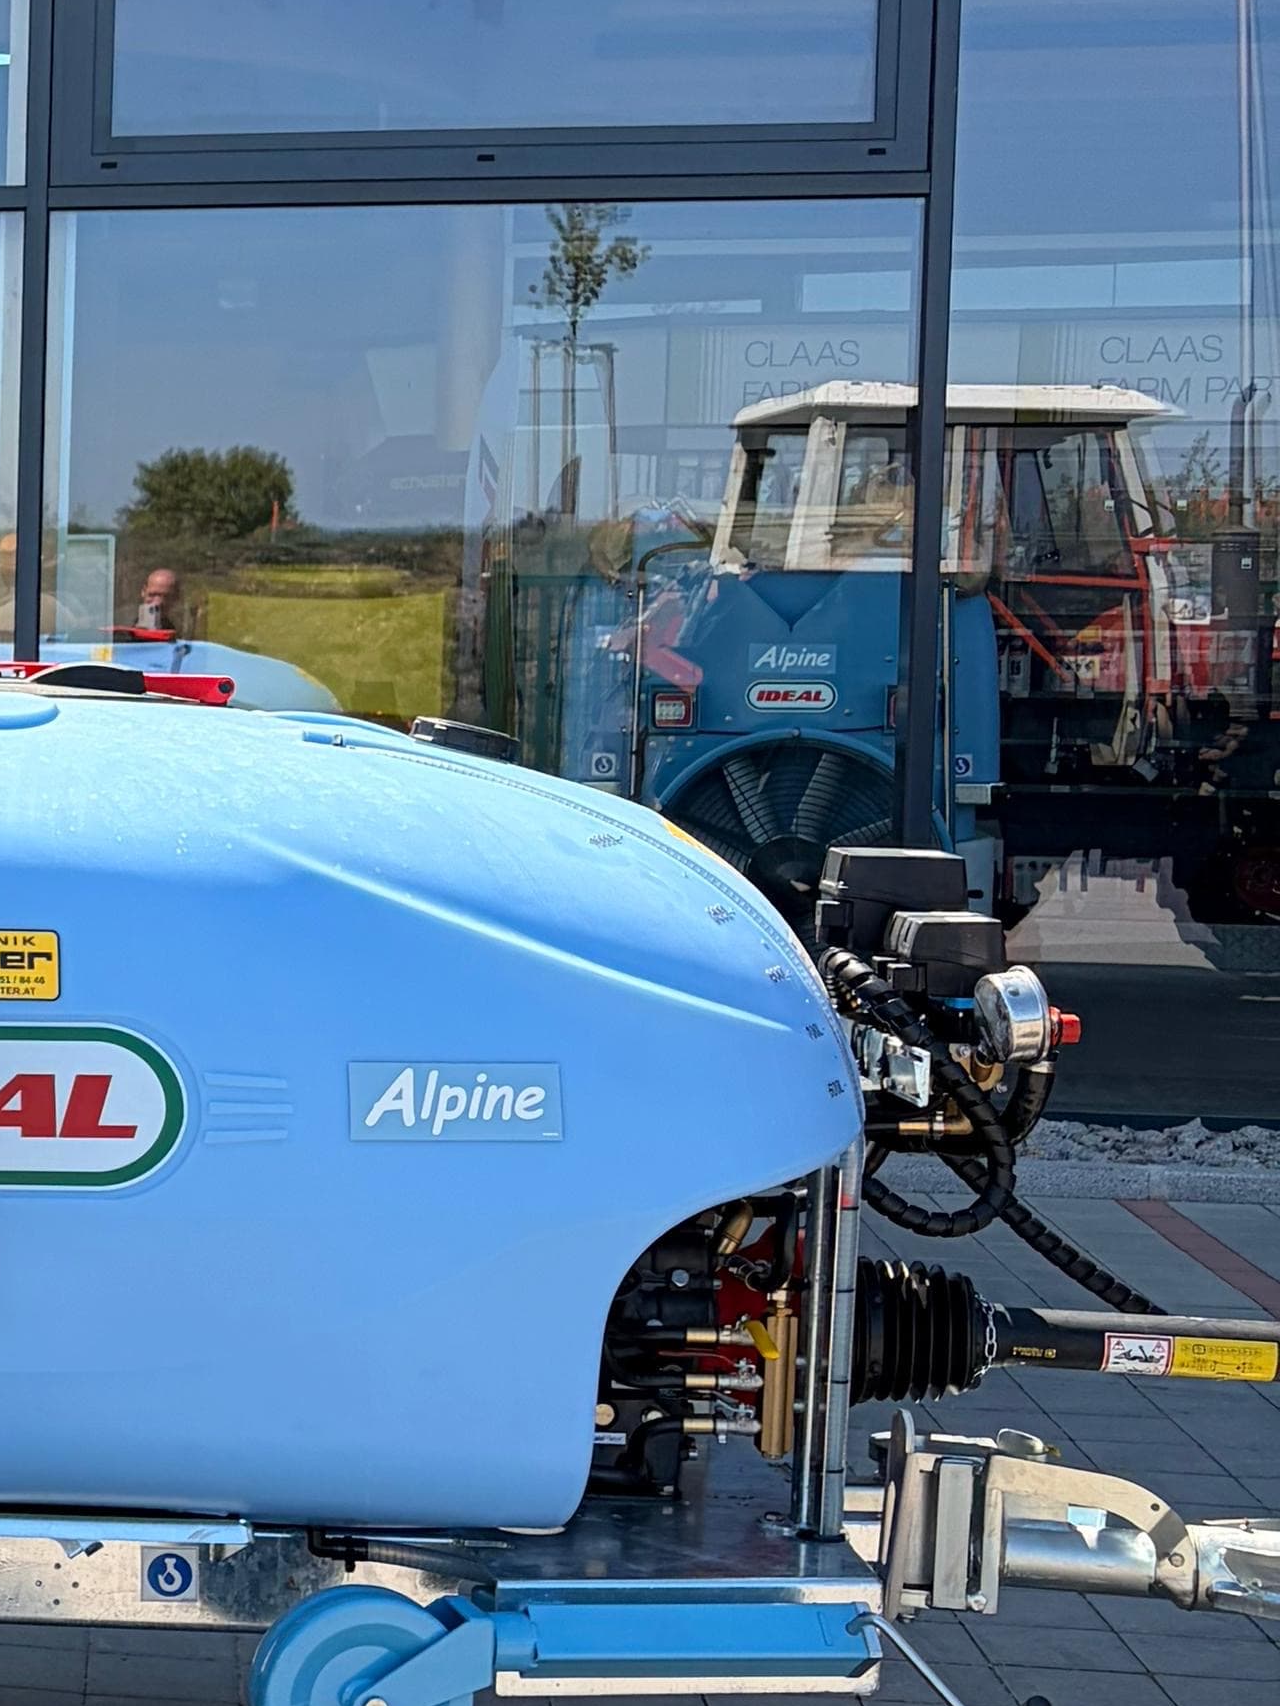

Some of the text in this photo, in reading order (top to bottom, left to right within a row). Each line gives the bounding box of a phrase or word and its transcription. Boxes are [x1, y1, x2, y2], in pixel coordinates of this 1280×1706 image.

[744, 339, 860, 369] CLAAS
[1099, 334, 1224, 365] CLAAS
[753, 645, 831, 673] Alpine
[756, 690, 827, 702] IDEAL
[364, 1067, 546, 1136] Alpine
